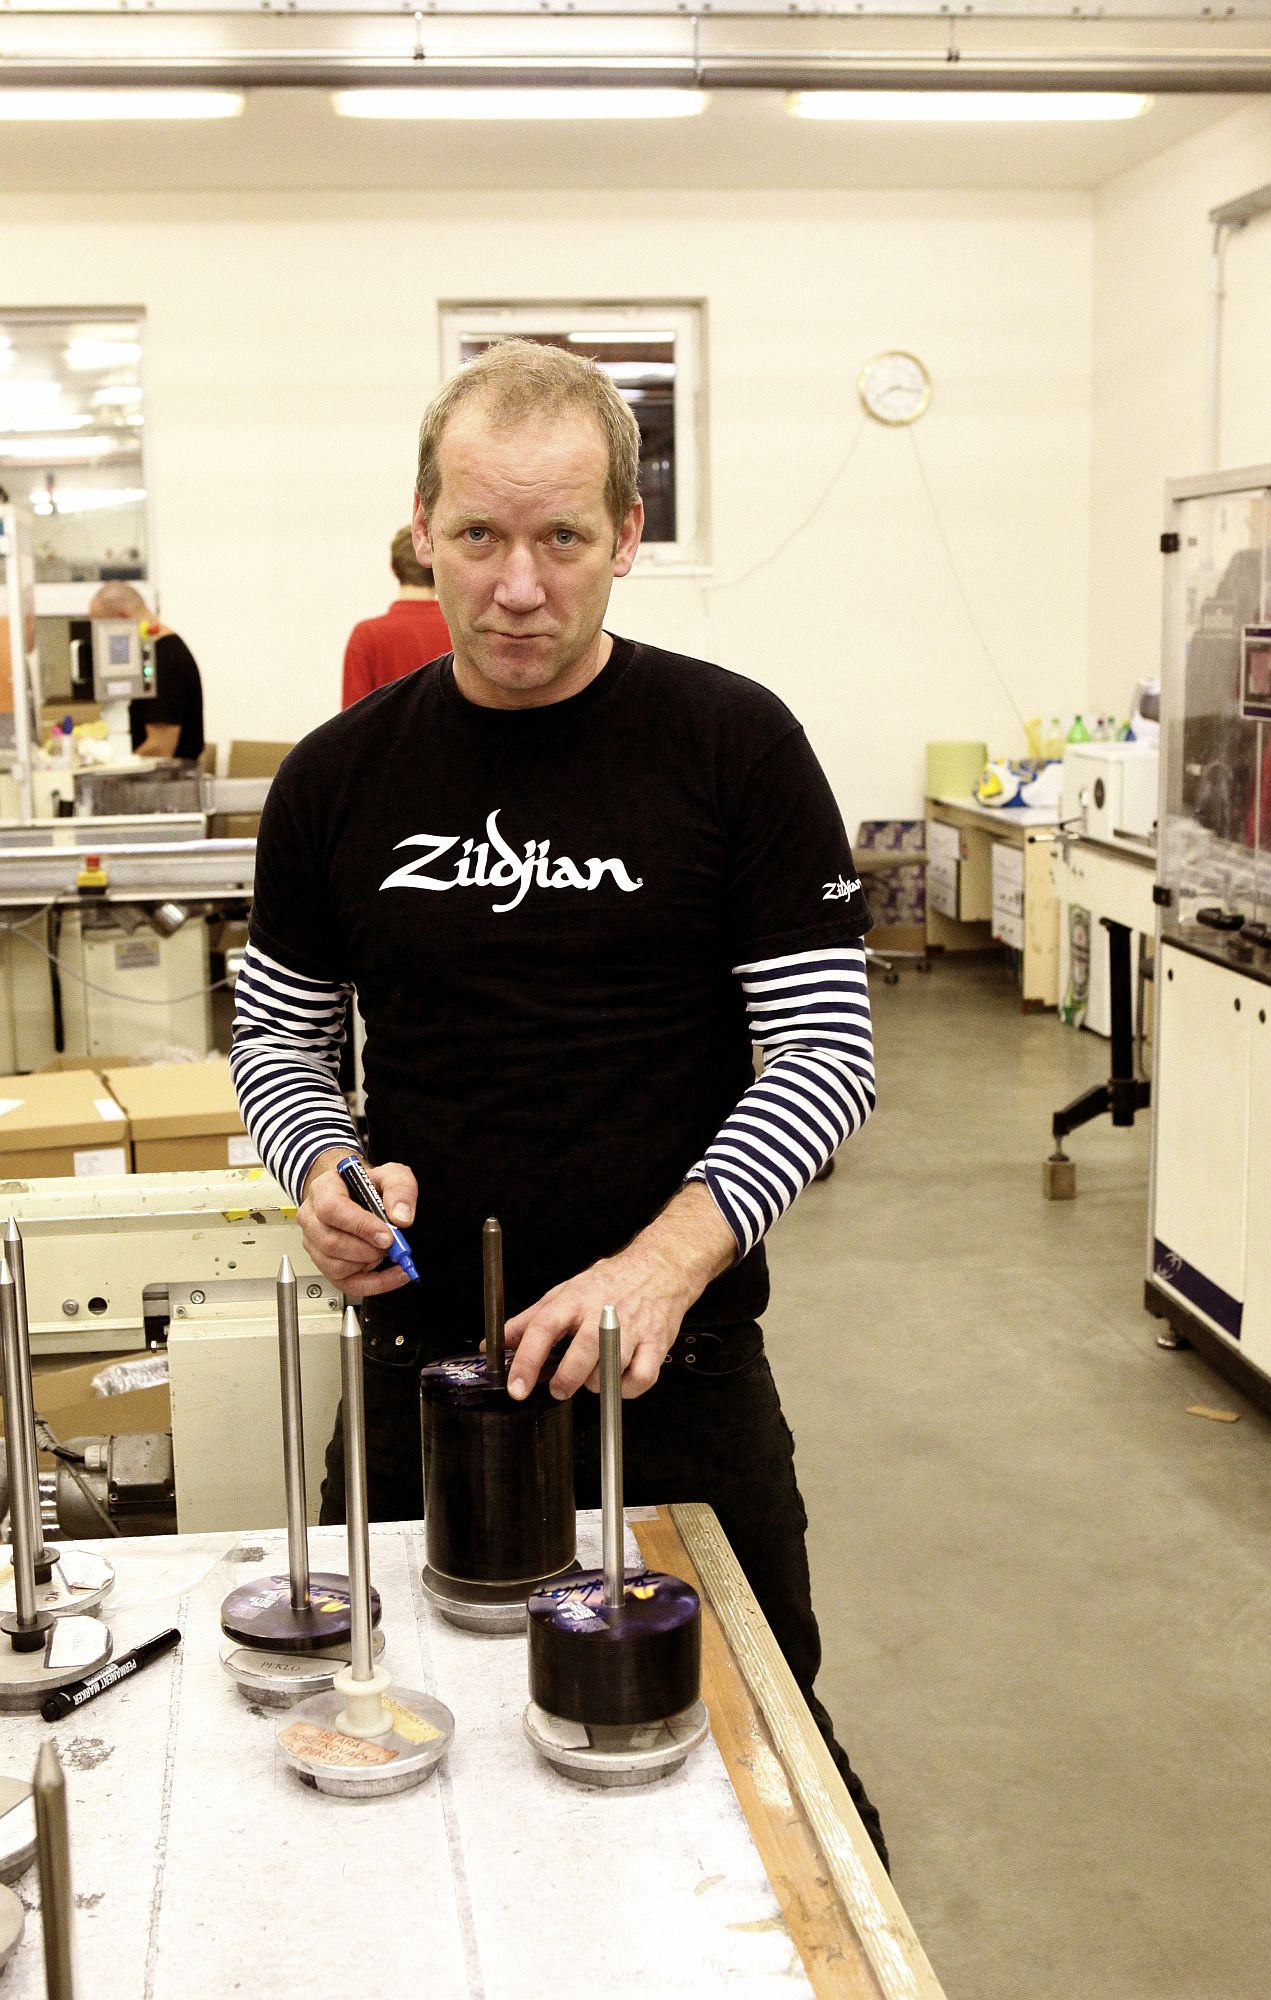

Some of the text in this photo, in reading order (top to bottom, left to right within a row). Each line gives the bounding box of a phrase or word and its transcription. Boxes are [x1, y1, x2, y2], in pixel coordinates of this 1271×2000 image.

[378, 808, 644, 914] Zildjian
[72, 1658, 137, 1706] PERMANENT MARKER
[260, 1661, 301, 1671] PEKLO
